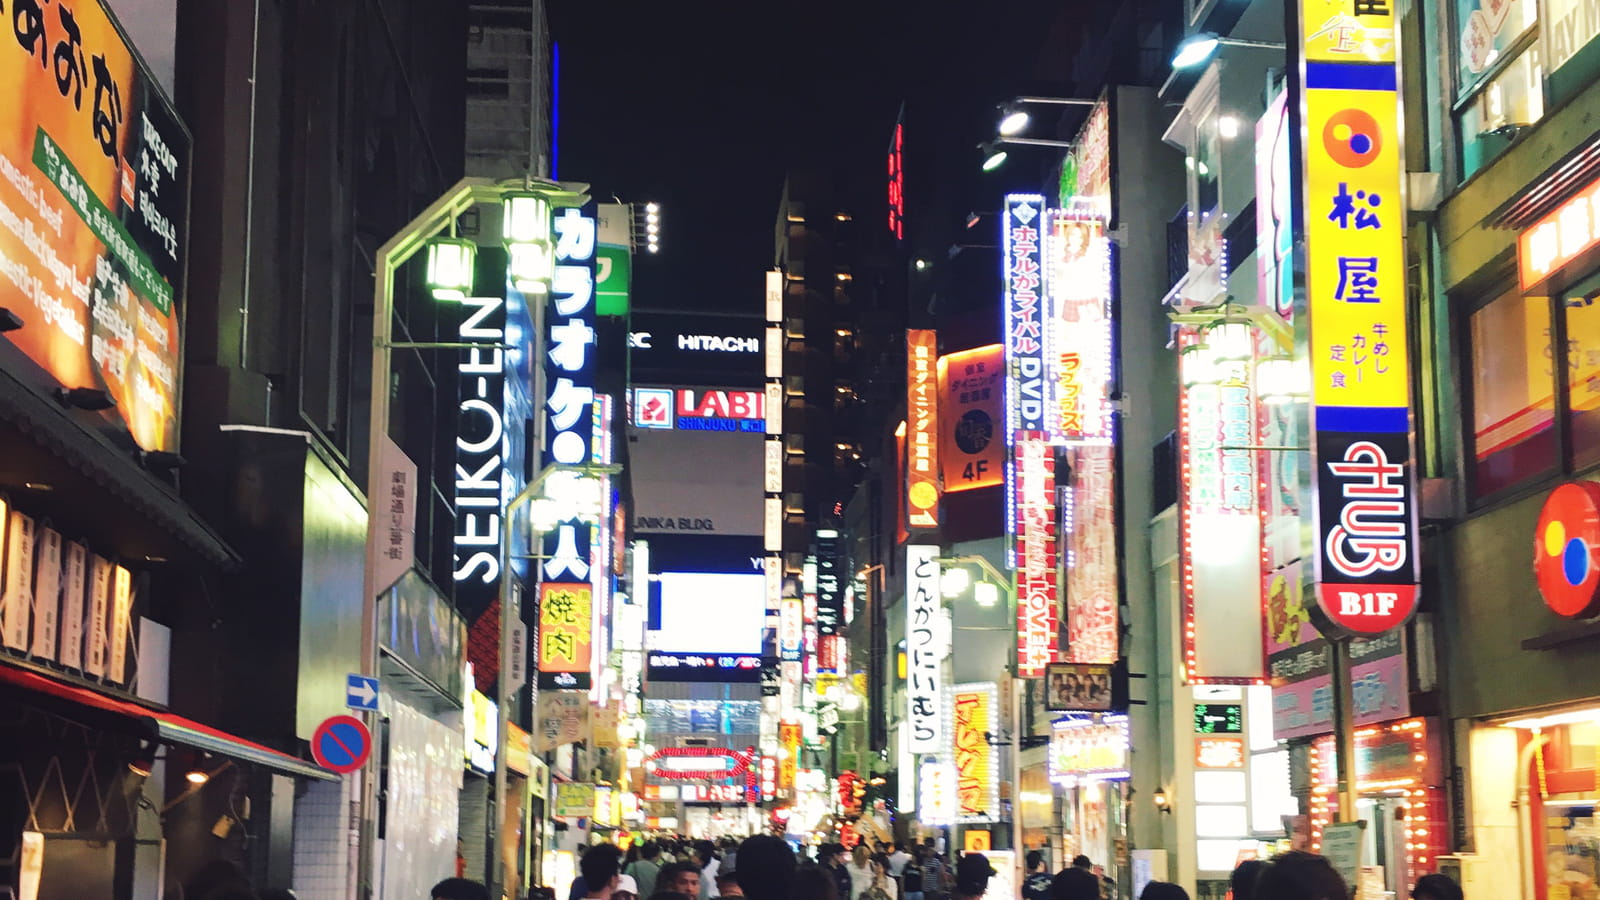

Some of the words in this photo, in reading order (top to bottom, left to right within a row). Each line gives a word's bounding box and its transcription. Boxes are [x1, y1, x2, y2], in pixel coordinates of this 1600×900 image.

[1328, 182, 1382, 304] 松屋
[1012, 225, 1041, 354] ホテルがライバル
[677, 334, 760, 353] HITACHI
[1329, 345, 1347, 388] 定食
[1351, 333, 1368, 382] カレー
[1372, 323, 1390, 374] 牛めし
[677, 389, 764, 419] LABI
[678, 417, 737, 431] SHINJUKU
[453, 297, 503, 583] SEIKO-EN
[963, 460, 988, 481] 4F
[544, 592, 577, 662] 焼肉
[1338, 591, 1398, 616] B1F
[912, 557, 935, 742] とんかつにいむら
